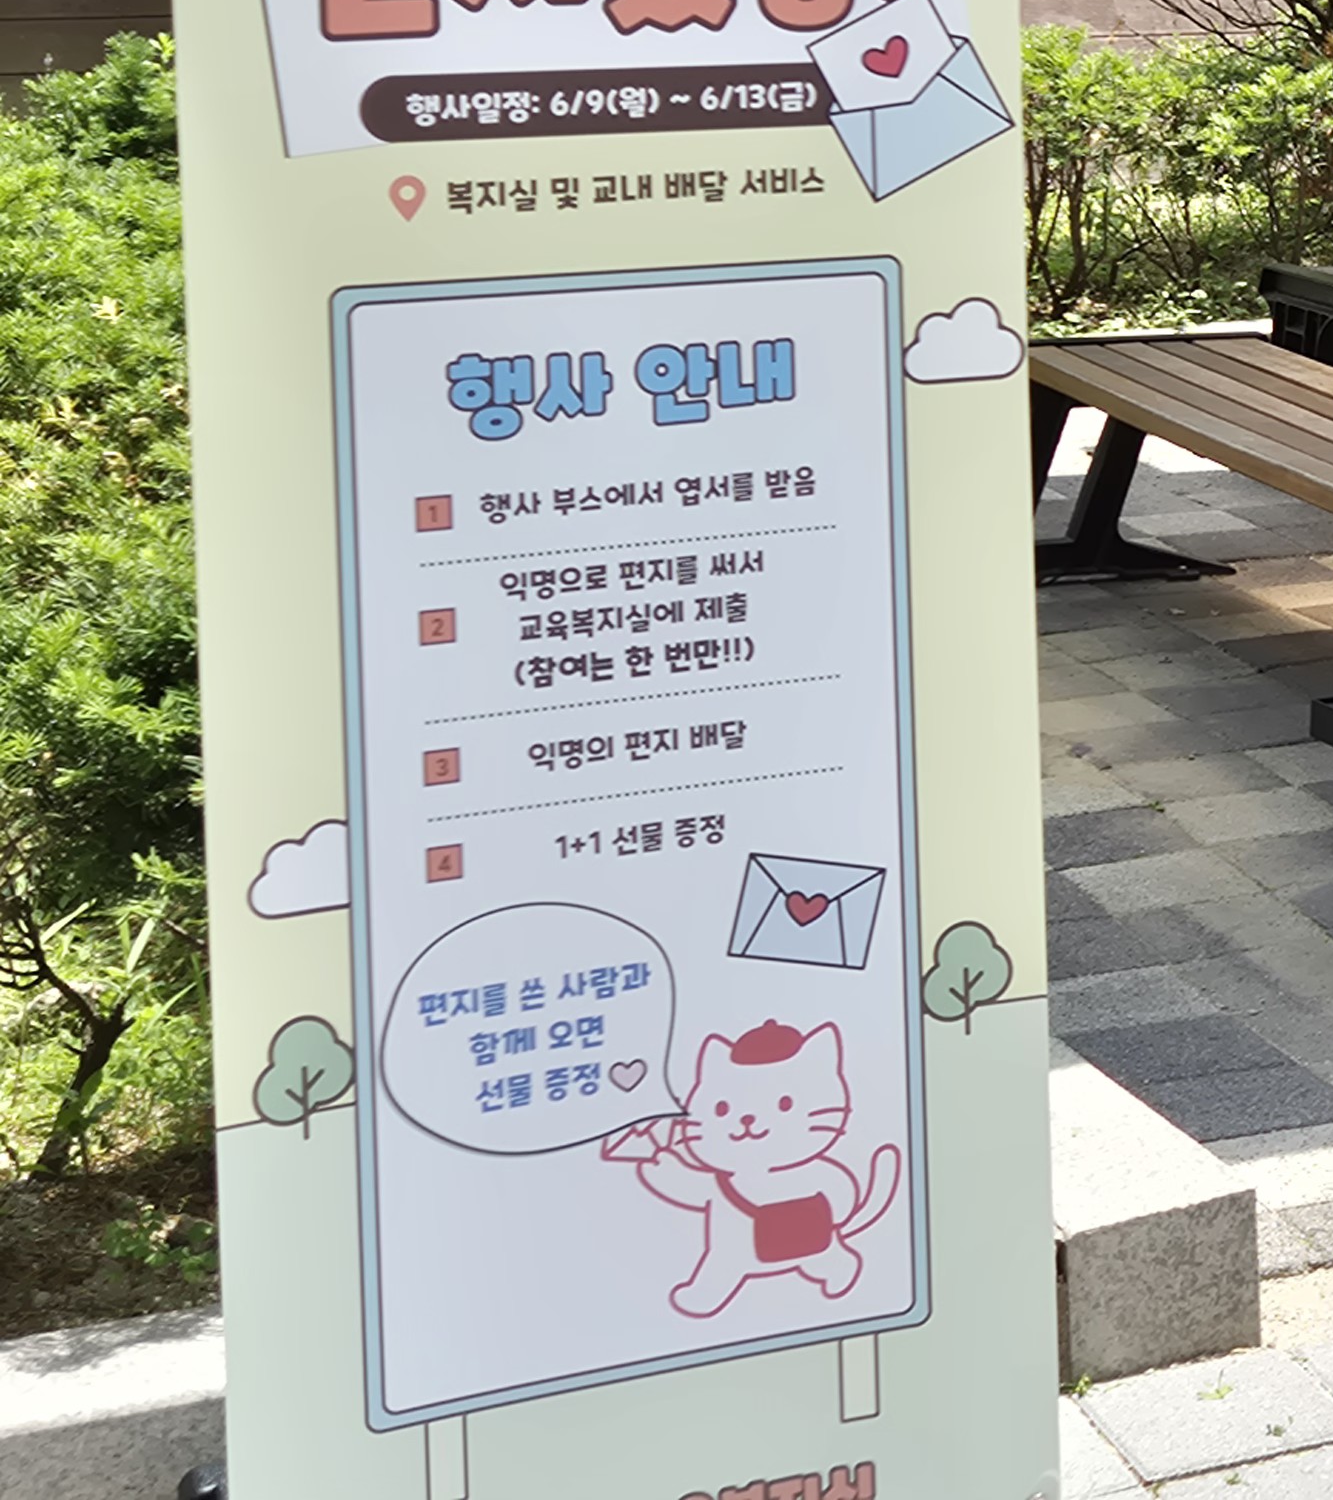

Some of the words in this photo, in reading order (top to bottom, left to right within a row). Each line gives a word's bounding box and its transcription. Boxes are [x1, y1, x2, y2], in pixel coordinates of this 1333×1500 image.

[405, 90, 540, 128] 행사일정:
[548, 86, 661, 119] 6/9(월)
[699, 81, 818, 114] 6/13(금)
[446, 178, 538, 216] 복지실
[550, 176, 580, 210] 및
[592, 173, 653, 204] 교내
[664, 169, 729, 202] 배달
[739, 166, 826, 196] 서비스
[446, 351, 613, 442] 행사
[634, 337, 796, 427] 안내
[479, 490, 542, 526] 행사
[552, 480, 664, 517] 부스에서
[674, 472, 754, 508] 엽서를
[764, 466, 817, 500] 받음
[499, 563, 609, 602] 익명으로
[618, 554, 699, 591] 편지를
[709, 550, 765, 578] 써서
[518, 600, 685, 642] 교육복지실에
[694, 592, 749, 624] 제출
[514, 651, 615, 689] (참여는
[624, 645, 655, 678] 한
[663, 635, 756, 674] 번만!!)
[527, 735, 615, 773] 익명의
[624, 728, 680, 762] 편지
[688, 720, 748, 750] 배달
[554, 830, 602, 860] 1+1
[611, 822, 664, 857] 선물
[674, 815, 727, 848] 증정
[418, 982, 509, 1028] 편지를
[518, 977, 547, 1012] 쓴
[557, 962, 653, 1001] 사람과
[468, 1026, 538, 1067] 함께
[547, 1014, 606, 1050] 오면
[475, 1072, 534, 1114] 선물
[544, 1062, 602, 1103] 증정
